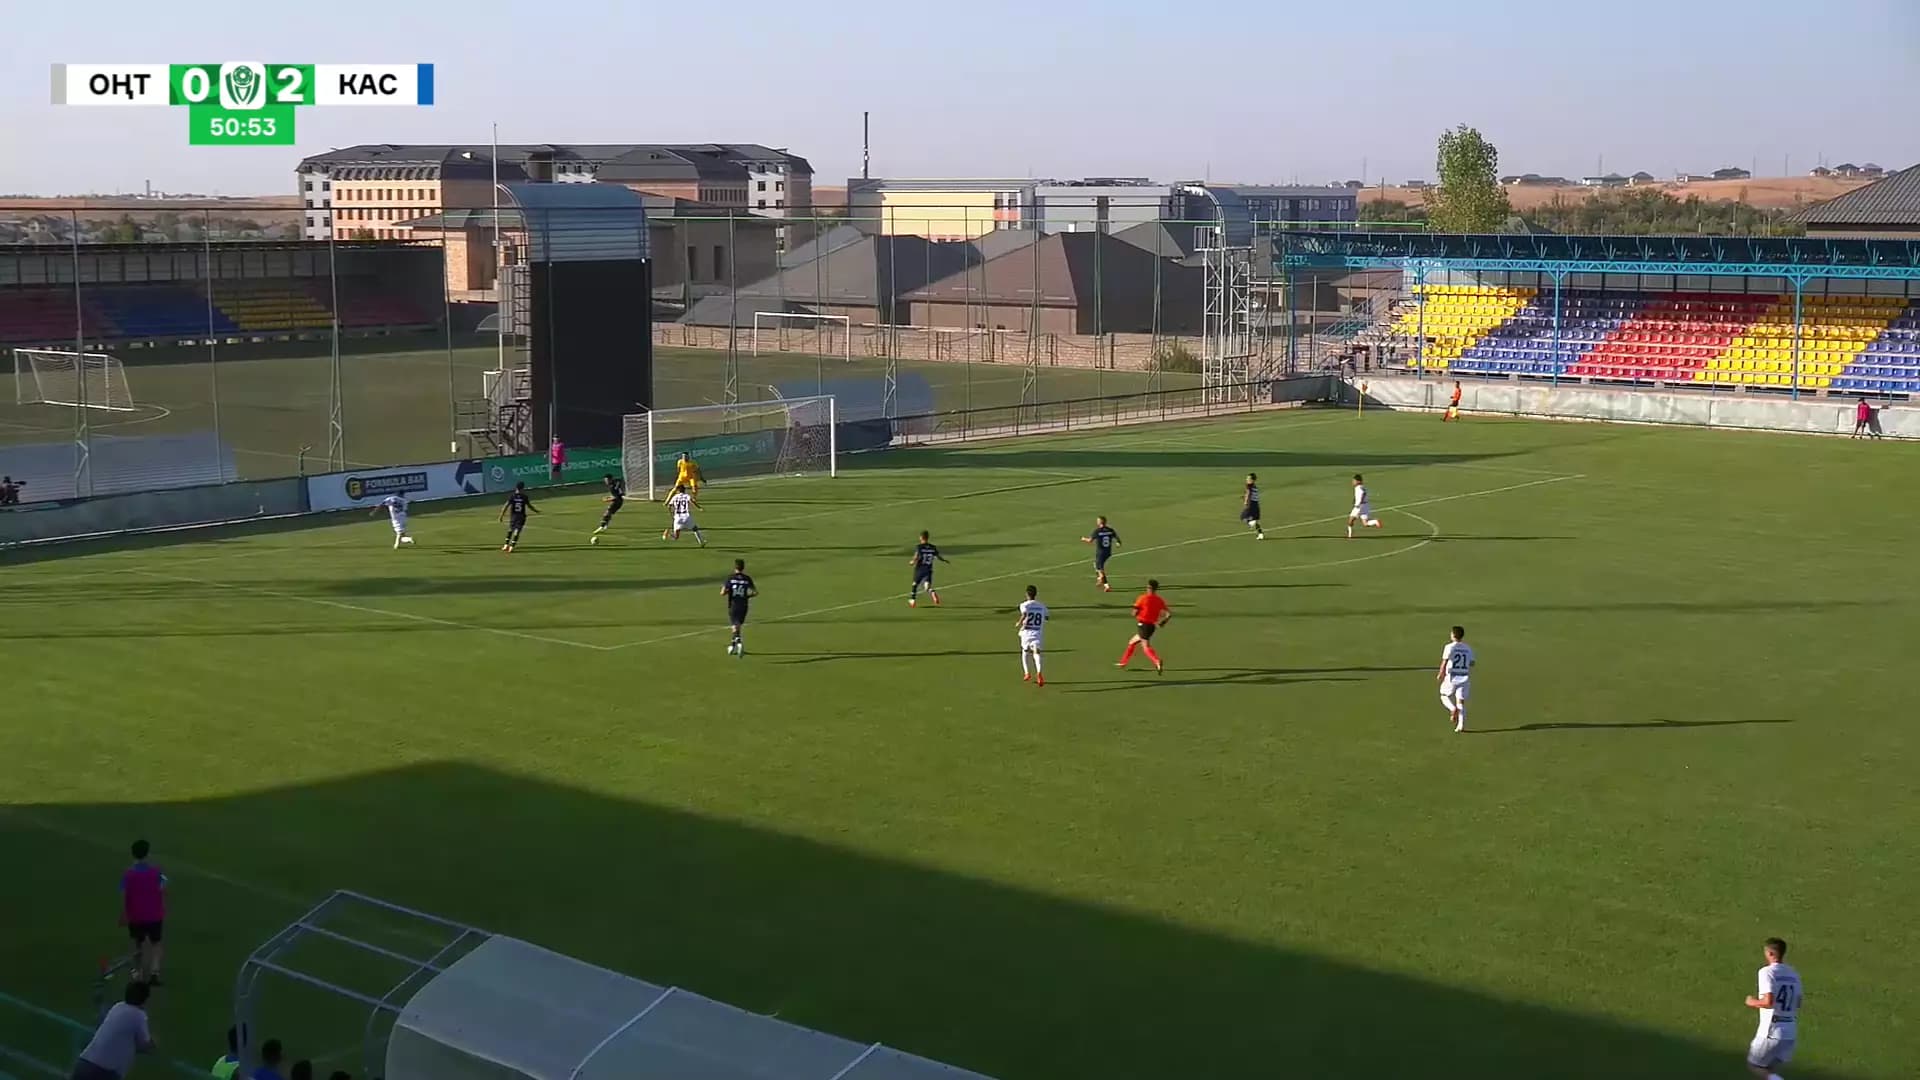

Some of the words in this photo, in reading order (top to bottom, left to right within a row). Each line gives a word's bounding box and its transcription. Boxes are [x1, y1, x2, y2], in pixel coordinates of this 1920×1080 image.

[1026, 612, 1042, 627] 28
[1452, 653, 1468, 670] 21
[1775, 984, 1795, 1012] 41
